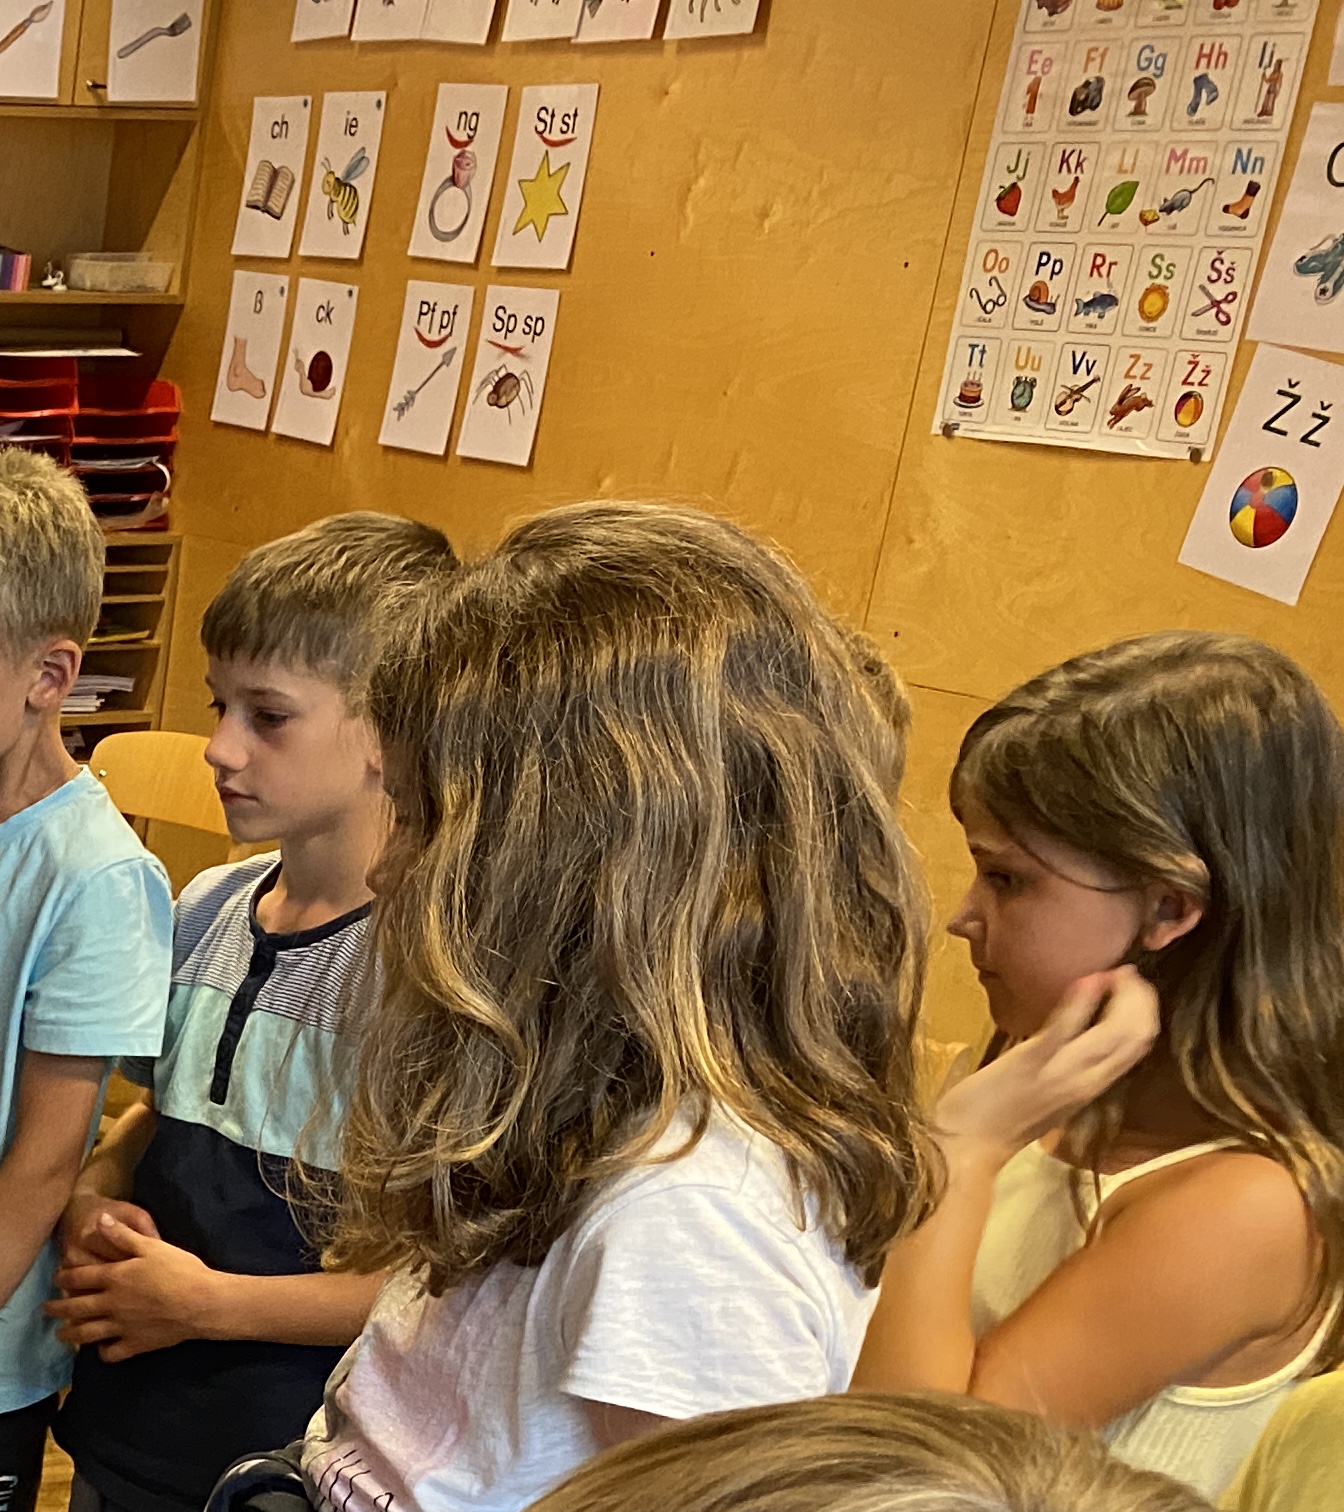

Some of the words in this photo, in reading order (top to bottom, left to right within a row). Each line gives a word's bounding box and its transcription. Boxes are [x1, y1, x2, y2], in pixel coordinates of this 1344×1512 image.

[1026, 49, 1053, 77] Ee
[1083, 46, 1110, 74] Ff
[1136, 44, 1168, 79] Gg
[1195, 42, 1229, 70] Hh
[270, 113, 290, 140] ch
[343, 110, 359, 137] ie
[457, 109, 481, 139] ng
[534, 106, 556, 136] St
[559, 108, 578, 135] st
[1007, 148, 1031, 182] Jj
[1058, 148, 1088, 175] Kk
[1116, 147, 1140, 175] Ll
[1165, 148, 1208, 176] Mm
[1231, 147, 1266, 176] Nn
[982, 248, 1010, 274] Oo
[1034, 250, 1064, 281] Pp
[1089, 252, 1118, 279] Rr
[1147, 253, 1176, 282] Ss
[1207, 249, 1237, 284] Šš
[315, 300, 334, 326] ck
[417, 300, 437, 334] Pf
[438, 304, 459, 336] pf
[492, 304, 517, 335] Sp
[522, 312, 545, 343] sp
[967, 343, 988, 369] Tt
[1014, 345, 1042, 372] Uu
[1070, 350, 1098, 376] Vv
[1123, 353, 1154, 380] Zz
[1180, 353, 1212, 388] Žž
[1261, 378, 1302, 437] Ž
[1299, 400, 1333, 448] ž
